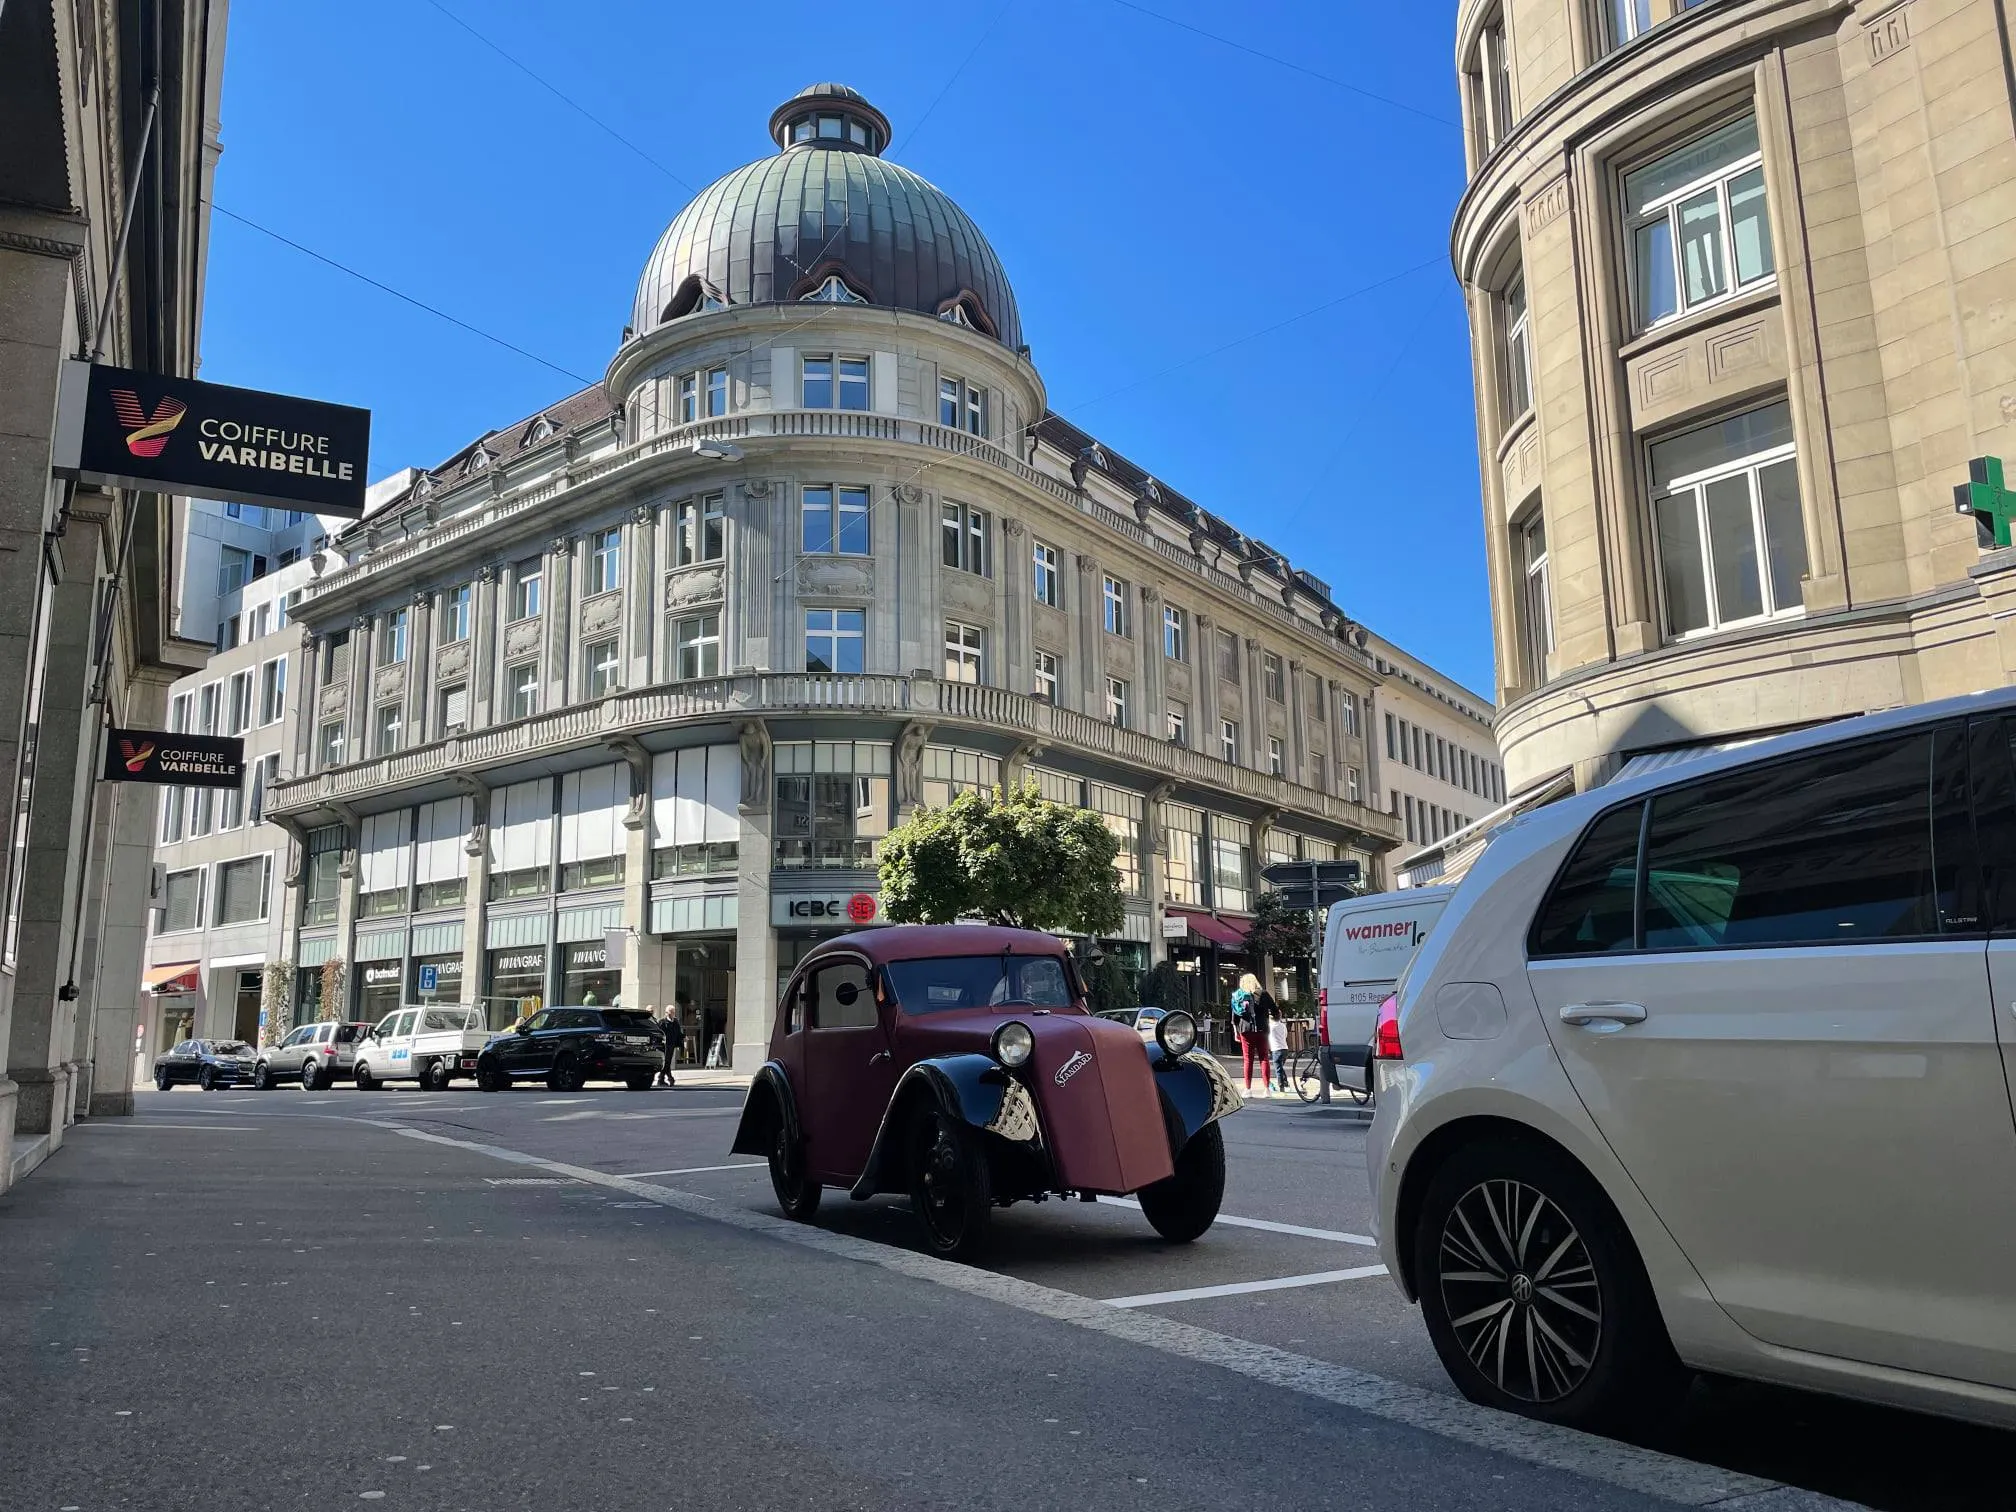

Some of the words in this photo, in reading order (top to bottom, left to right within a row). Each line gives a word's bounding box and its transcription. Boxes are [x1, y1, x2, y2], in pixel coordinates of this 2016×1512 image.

[200, 419, 329, 455] COIFFURE
[198, 440, 353, 481] VARIBELLE
[160, 749, 225, 763] COIFFURE
[160, 761, 236, 775] VARIBELLE
[789, 900, 840, 917] ICBC
[1345, 921, 1413, 941] wanner
[426, 968, 433, 980] P
[1350, 993, 1367, 1003] 8105
